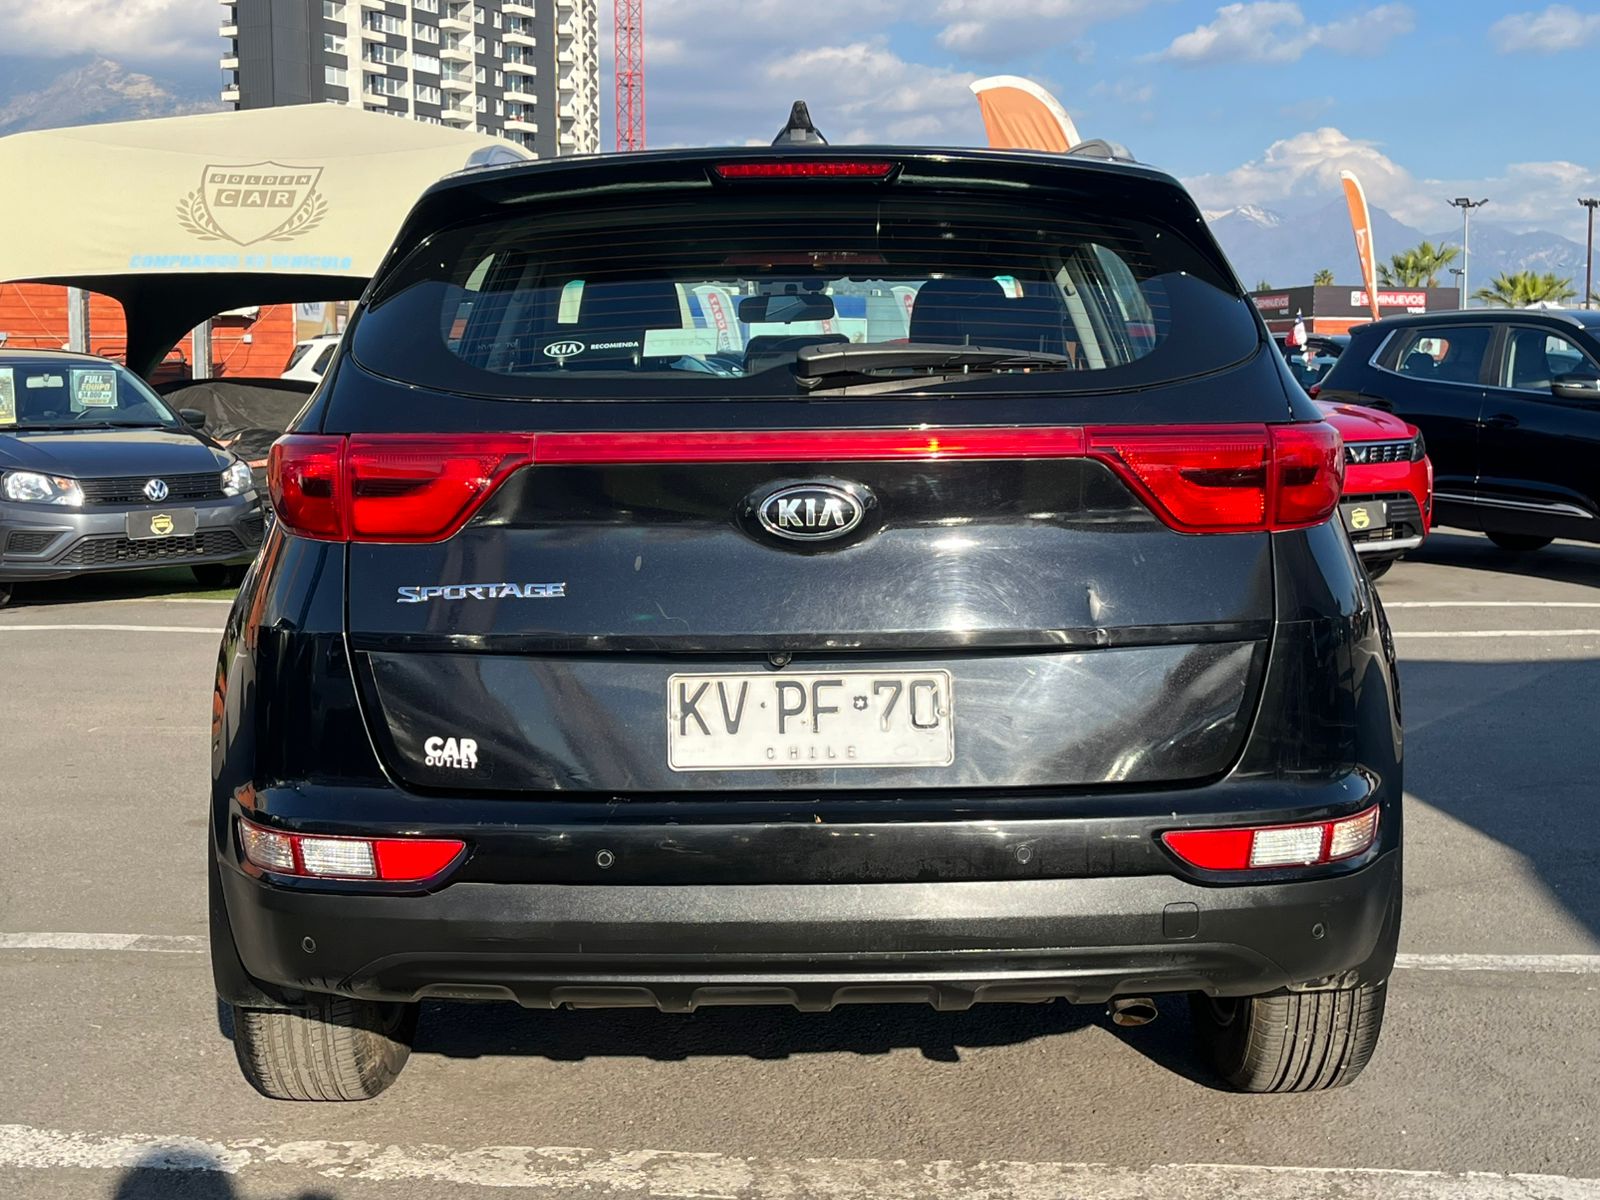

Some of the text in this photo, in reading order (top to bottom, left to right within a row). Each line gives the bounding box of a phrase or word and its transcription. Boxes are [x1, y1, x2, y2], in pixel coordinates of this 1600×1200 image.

[213, 175, 308, 184] GOLDEN
[220, 191, 289, 204] CAR
[1361, 294, 1425, 304] SMINUEVOS
[550, 344, 582, 355] KIA
[590, 342, 639, 350] RECOMIENDA
[84, 375, 103, 384] FULL
[777, 498, 845, 527] KIA
[397, 582, 566, 603] SPORTAGE
[679, 679, 940, 736] KV PF 70
[424, 736, 478, 760] CAR
[765, 746, 857, 760] CHILE
[425, 757, 478, 769] OUTLET
